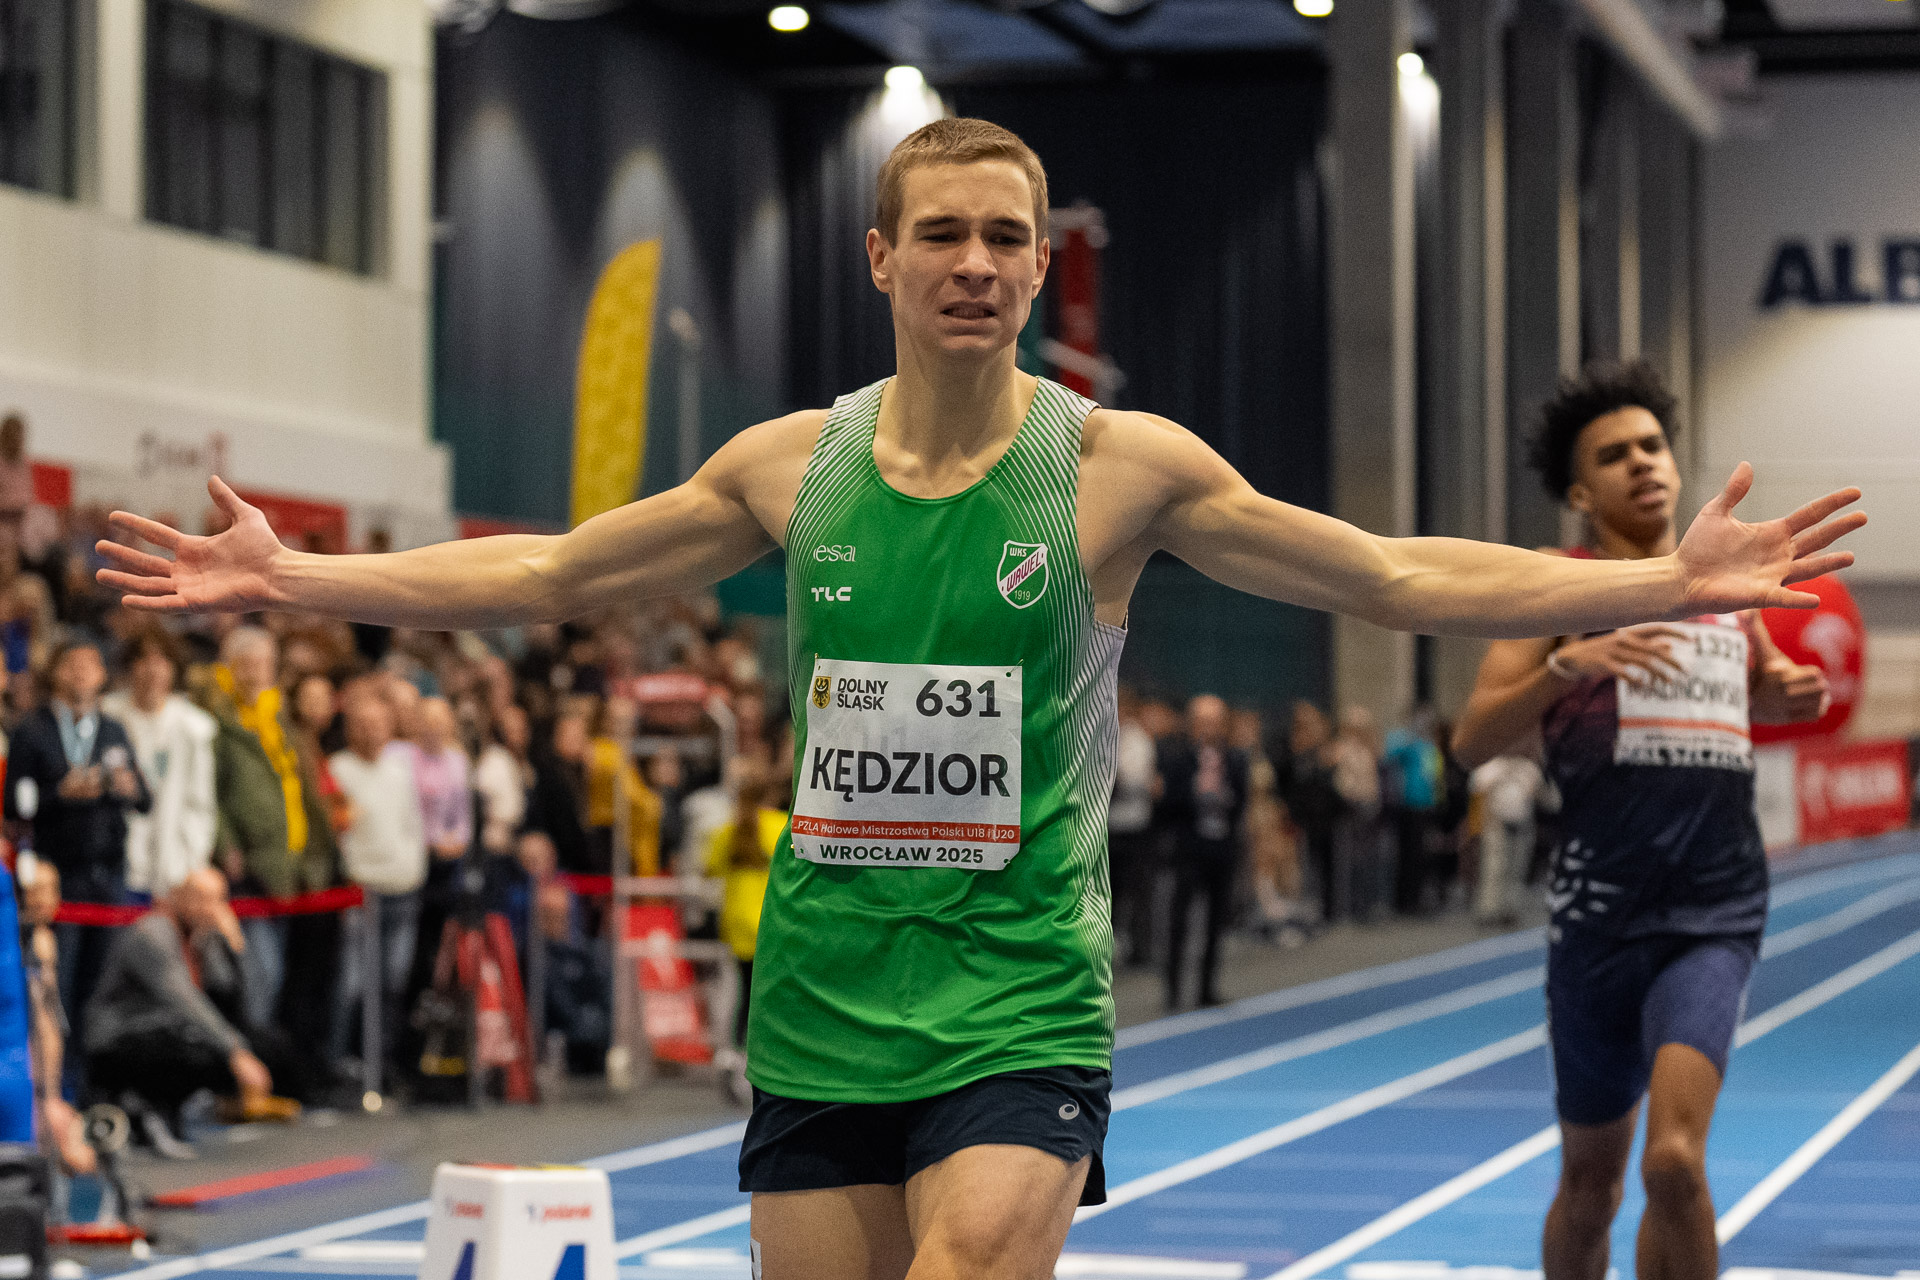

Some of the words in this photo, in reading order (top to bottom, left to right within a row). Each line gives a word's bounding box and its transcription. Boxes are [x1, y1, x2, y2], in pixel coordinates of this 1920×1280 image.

[1009, 547, 1027, 557] WKS
[1006, 551, 1042, 592] WAWEL
[811, 586, 852, 602] TLC
[1014, 589, 1031, 601] 1919
[836, 678, 889, 695] DOLNY
[836, 690, 885, 711] ŚLĄSK
[915, 679, 1001, 717] 631
[809, 746, 1011, 802] KĘDZIOR
[798, 820, 819, 832] PZLA
[820, 823, 859, 835] Halowe
[932, 826, 964, 837] Polski
[967, 827, 985, 838] U18
[993, 829, 1015, 839] U20
[819, 844, 932, 862] WROCŁAW
[936, 846, 984, 863] 2025
